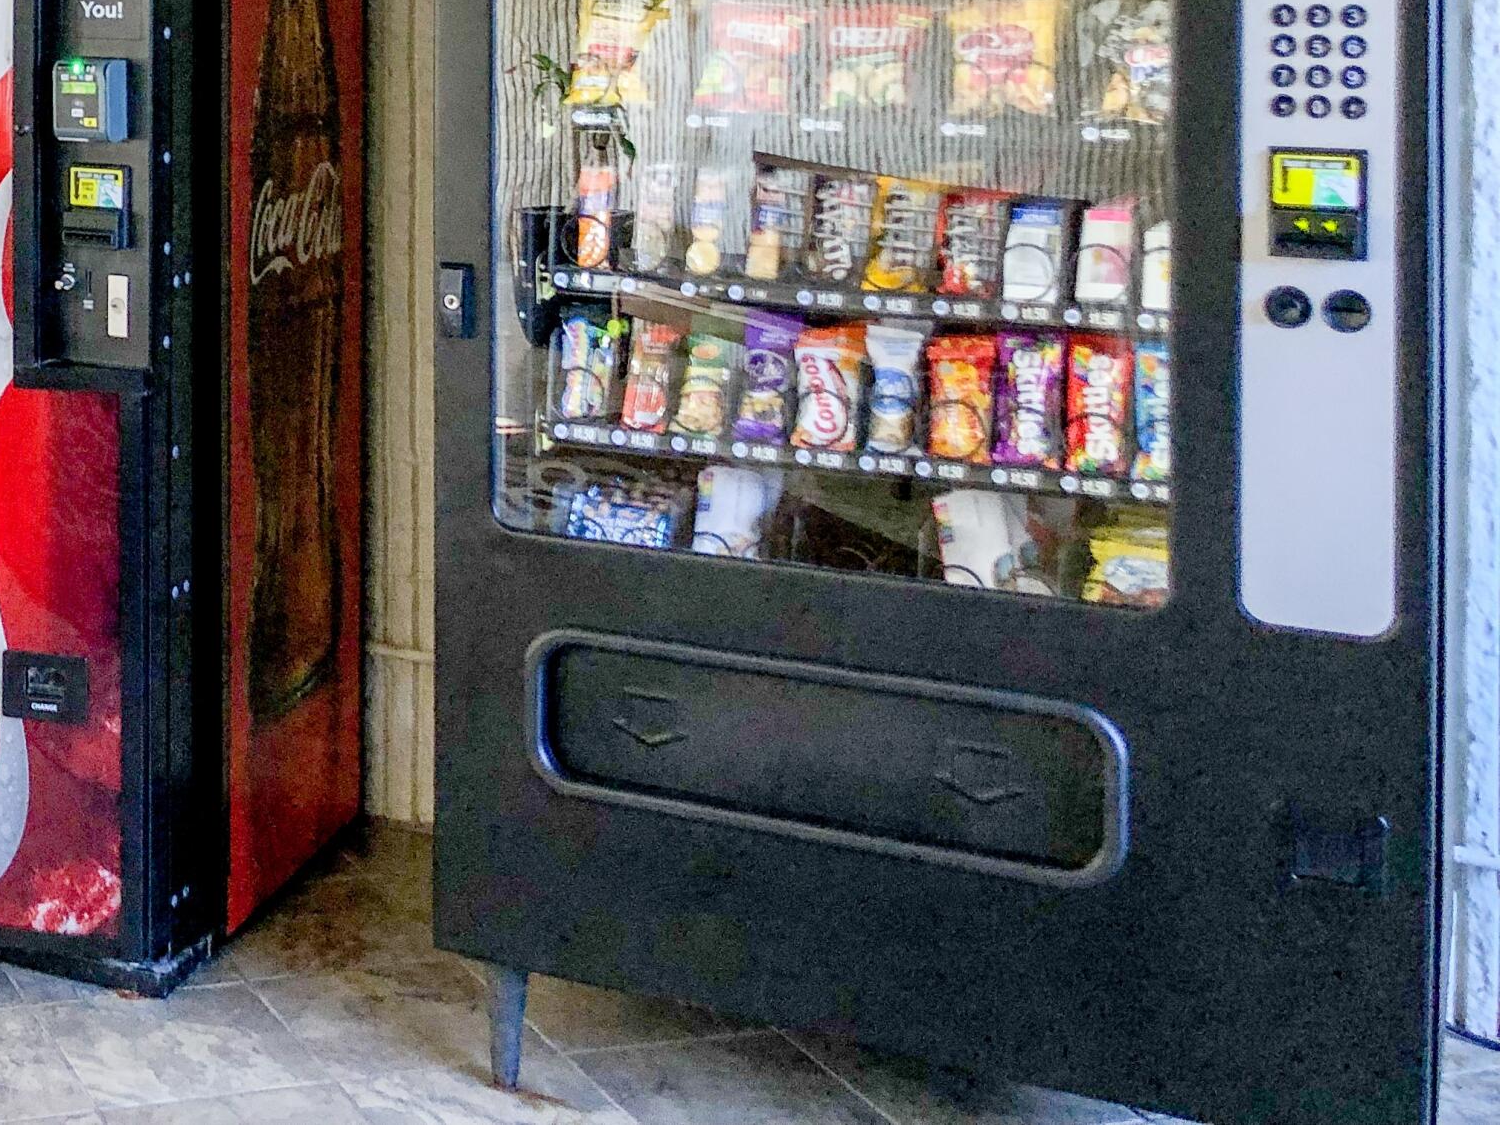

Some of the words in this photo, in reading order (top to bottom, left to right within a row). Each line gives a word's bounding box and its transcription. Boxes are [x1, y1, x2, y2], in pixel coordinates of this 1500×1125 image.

[80, 0, 123, 19] You!
[802, 355, 837, 434] Combos
[31, 702, 57, 713] CHANGE
